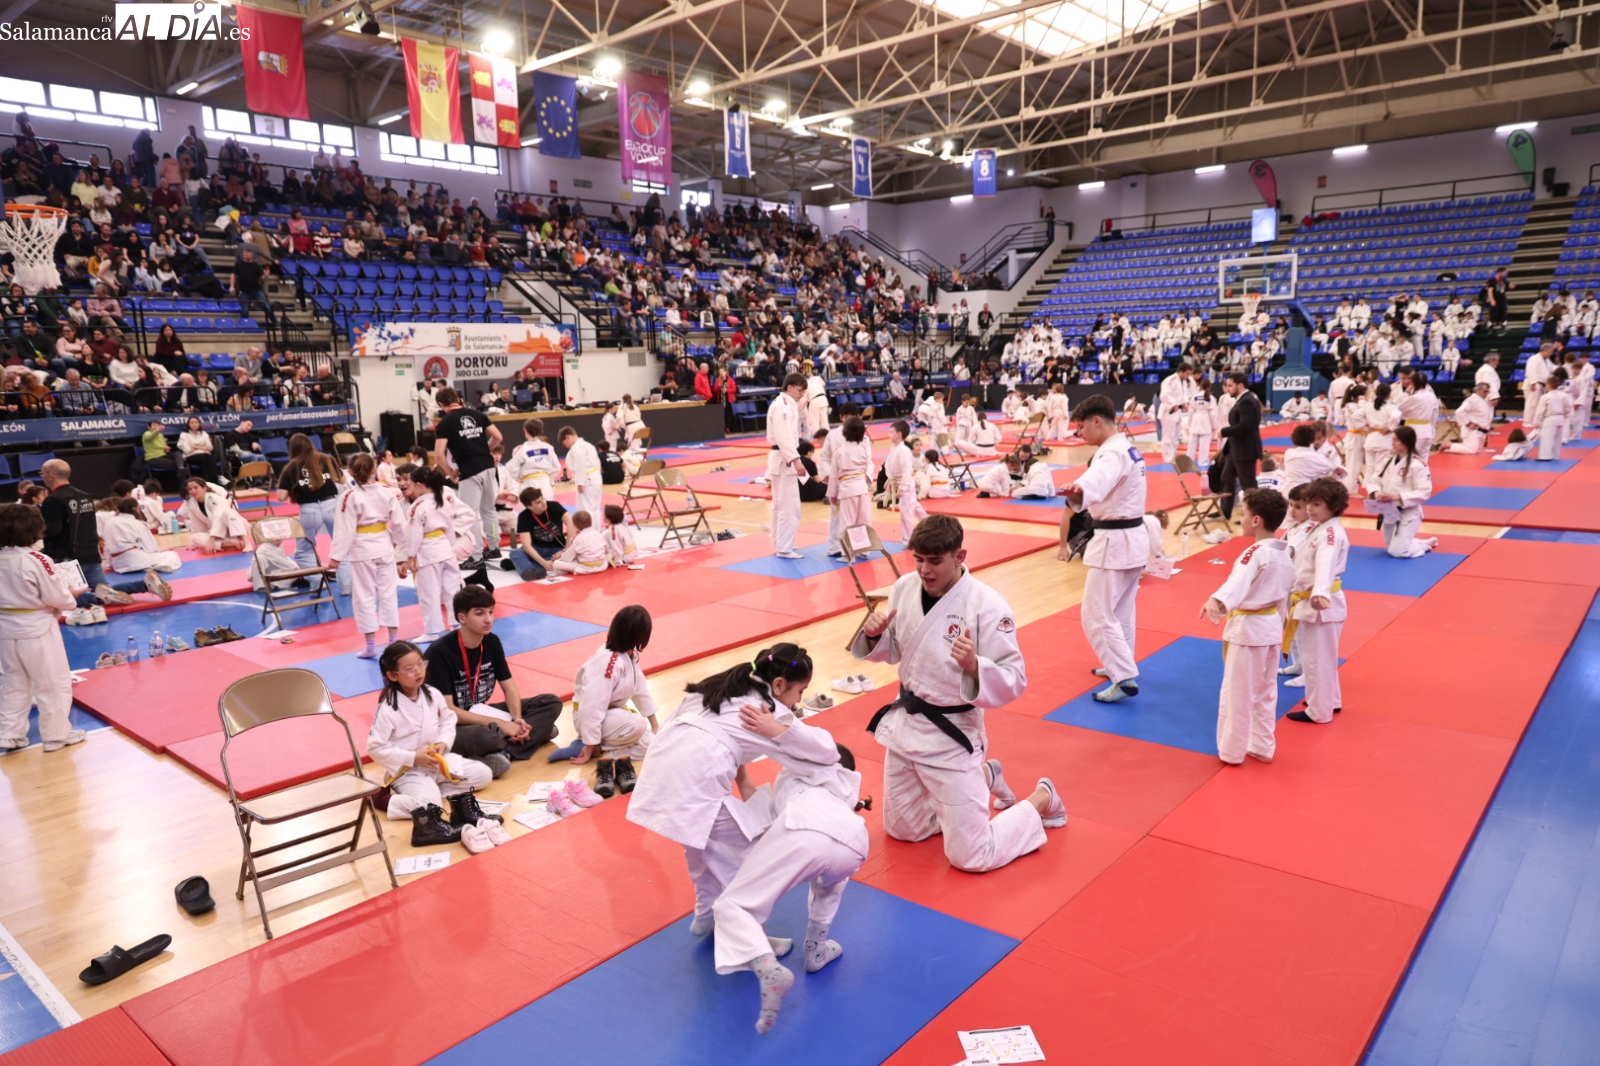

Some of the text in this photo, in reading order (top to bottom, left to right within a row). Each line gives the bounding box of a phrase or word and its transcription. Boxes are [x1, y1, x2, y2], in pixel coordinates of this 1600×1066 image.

[980, 159, 989, 177] 8
[455, 356, 508, 368] DORYOKU
[61, 419, 126, 431] SALAMANCA
[161, 413, 240, 425] CASTIA Y LEÓN
